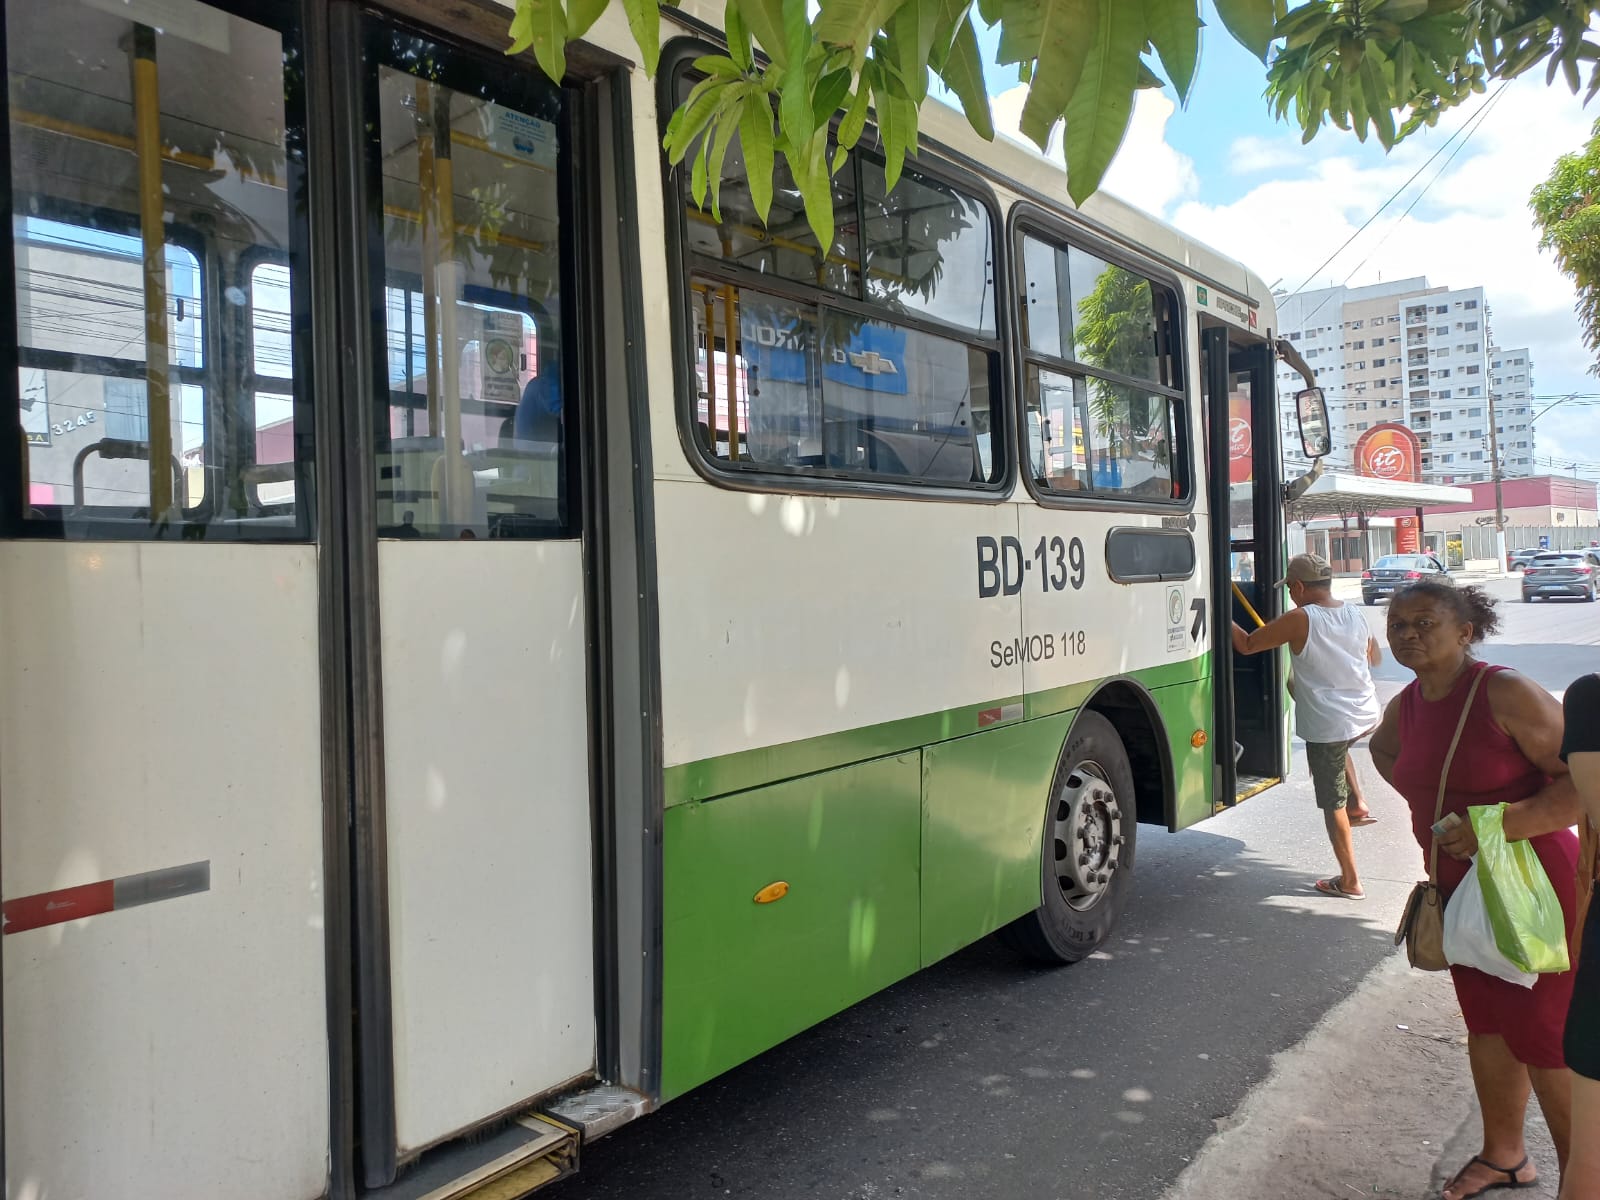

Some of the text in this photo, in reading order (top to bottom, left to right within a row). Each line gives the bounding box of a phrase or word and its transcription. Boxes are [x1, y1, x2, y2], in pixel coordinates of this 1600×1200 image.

[505, 112, 541, 128] ATENÇÃO
[51, 411, 97, 436] 3245
[1373, 449, 1401, 466] it
[990, 630, 1086, 668] SeMOB 118
